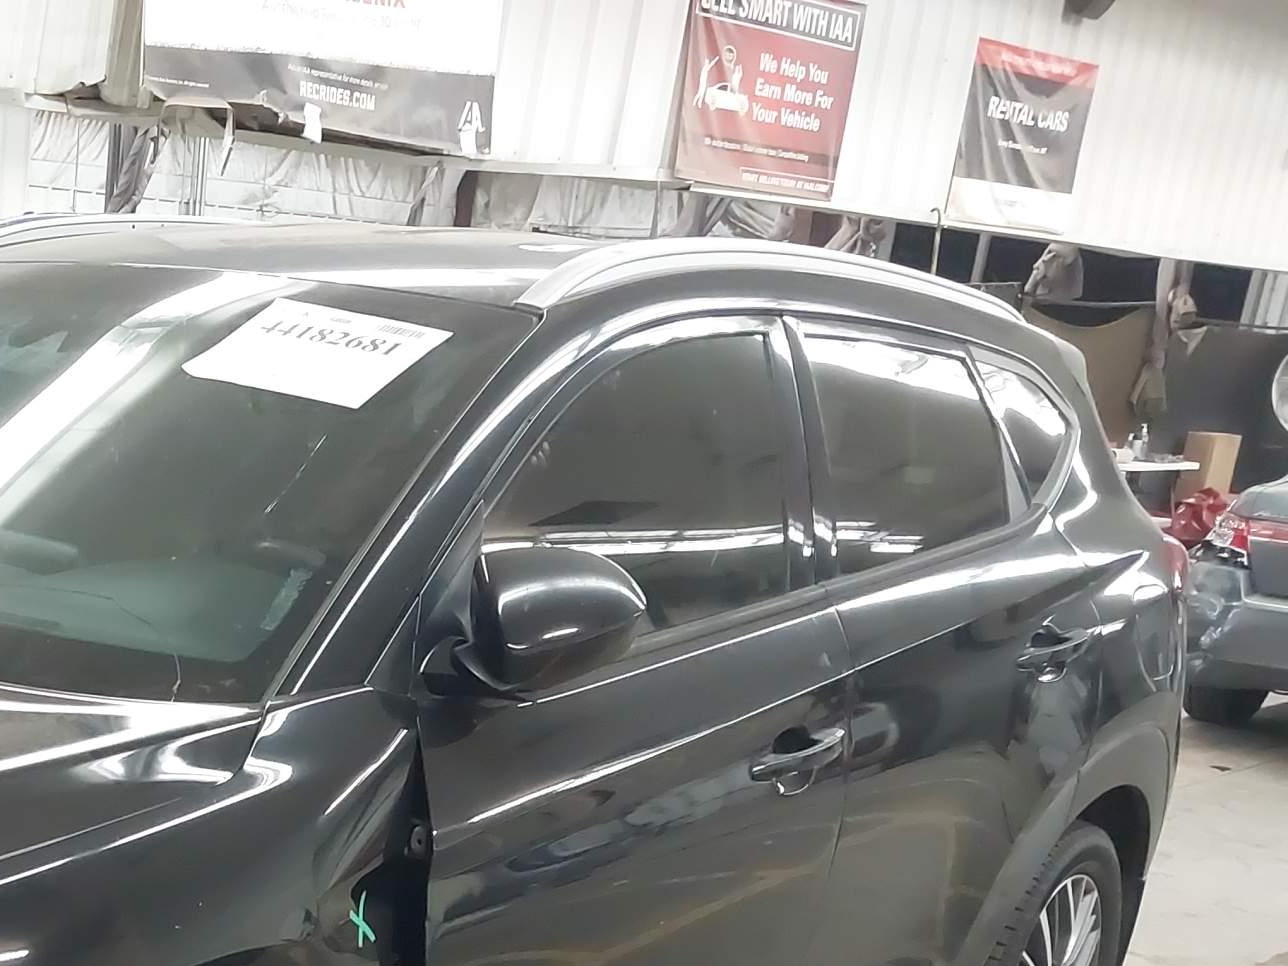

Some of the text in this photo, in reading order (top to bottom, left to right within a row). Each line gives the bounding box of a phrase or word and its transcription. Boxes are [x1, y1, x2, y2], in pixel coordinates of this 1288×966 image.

[739, 0, 792, 27] SMART
[793, 4, 830, 37] WITH
[829, 14, 853, 43] IAA
[759, 52, 778, 73] We
[779, 57, 806, 82] Help
[808, 62, 829, 84] You
[299, 80, 376, 111] RECRIDES.COM
[754, 78, 834, 110] Earn More For
[751, 102, 821, 132] Your Vehicle
[987, 95, 1070, 133] RENTAL CARS
[260, 320, 403, 356] 44182681
